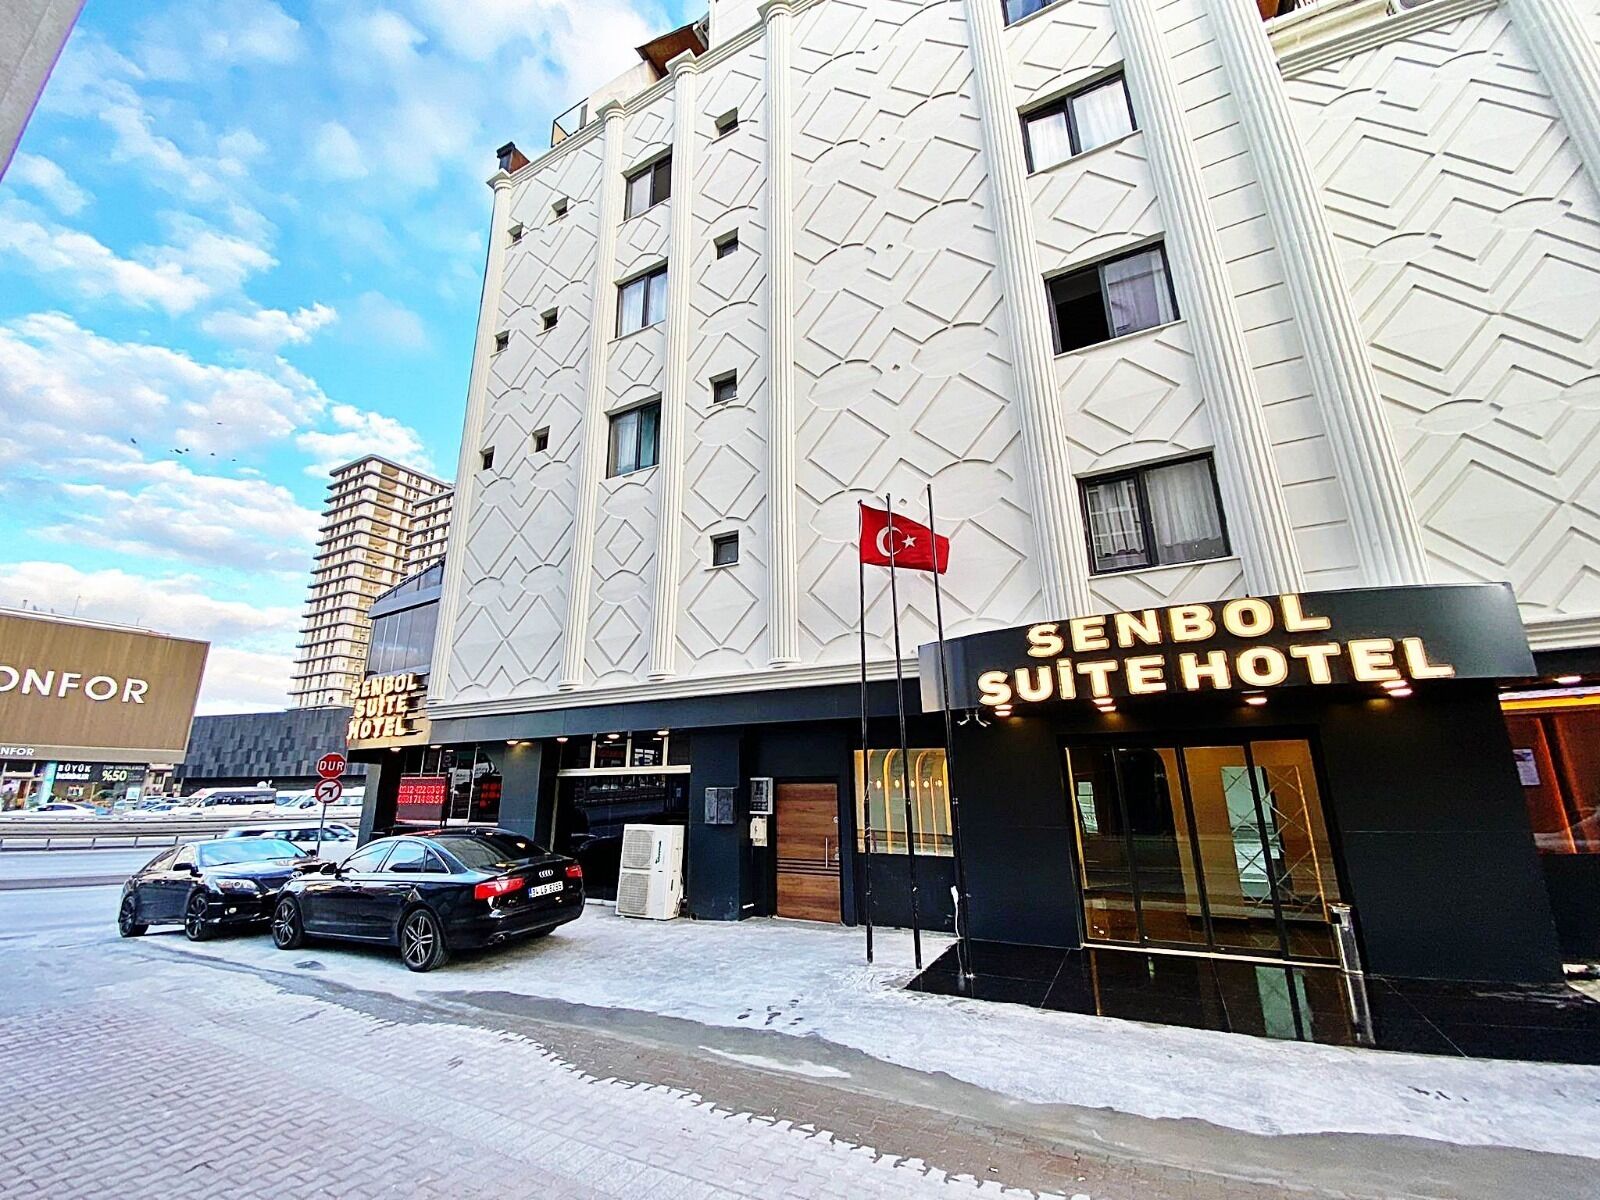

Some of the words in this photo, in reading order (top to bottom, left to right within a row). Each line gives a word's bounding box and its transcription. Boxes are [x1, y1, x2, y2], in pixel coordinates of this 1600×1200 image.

[1026, 593, 1331, 658] SENBOL
[1178, 637, 1455, 691] HOTEL
[351, 673, 417, 699] SENBOL
[346, 717, 407, 739] HOTEL
[57, 763, 92, 773] BÜYÜK
[102, 770, 128, 781] %50
[319, 761, 345, 772] DUR
